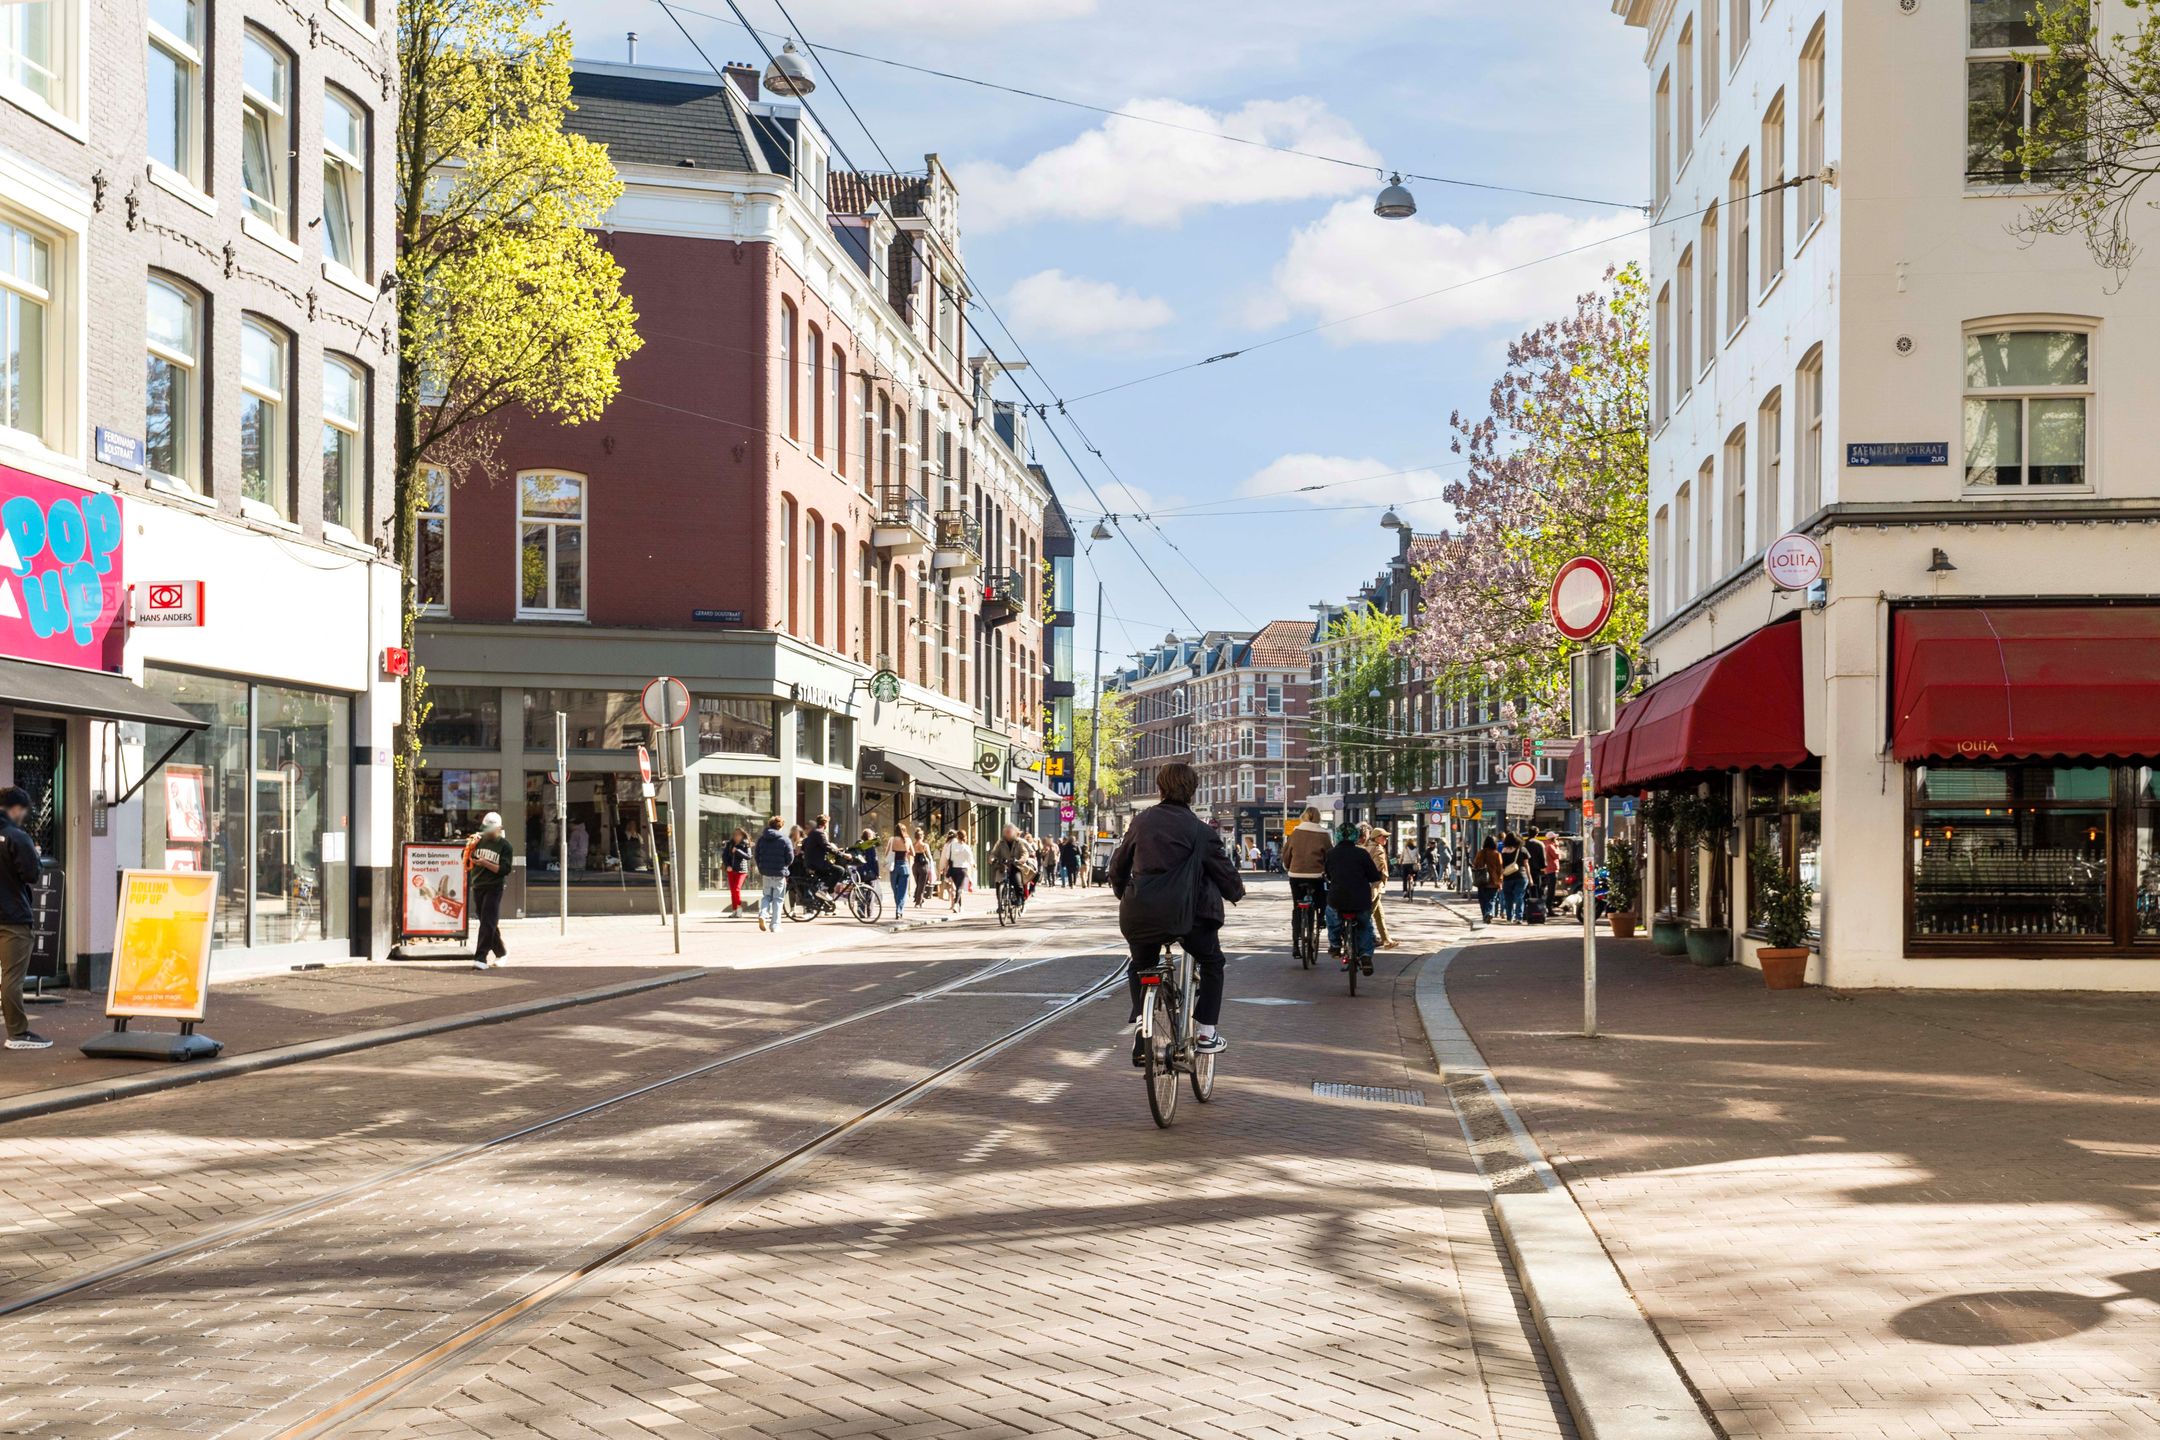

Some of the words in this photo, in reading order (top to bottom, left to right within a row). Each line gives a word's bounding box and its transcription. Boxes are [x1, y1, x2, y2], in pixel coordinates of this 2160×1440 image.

[104, 430, 136, 450] FERDINAND
[103, 442, 134, 461] BOLSTRAAT
[1772, 554, 1818, 569] LOLITA
[140, 614, 161, 622] HANS
[163, 613, 193, 622] ANDERS
[1957, 740, 1999, 753] LOLITA
[1057, 782, 1071, 795] M
[131, 882, 169, 894] ROLLING
[130, 893, 147, 904] POP
[149, 893, 163, 904] UP
